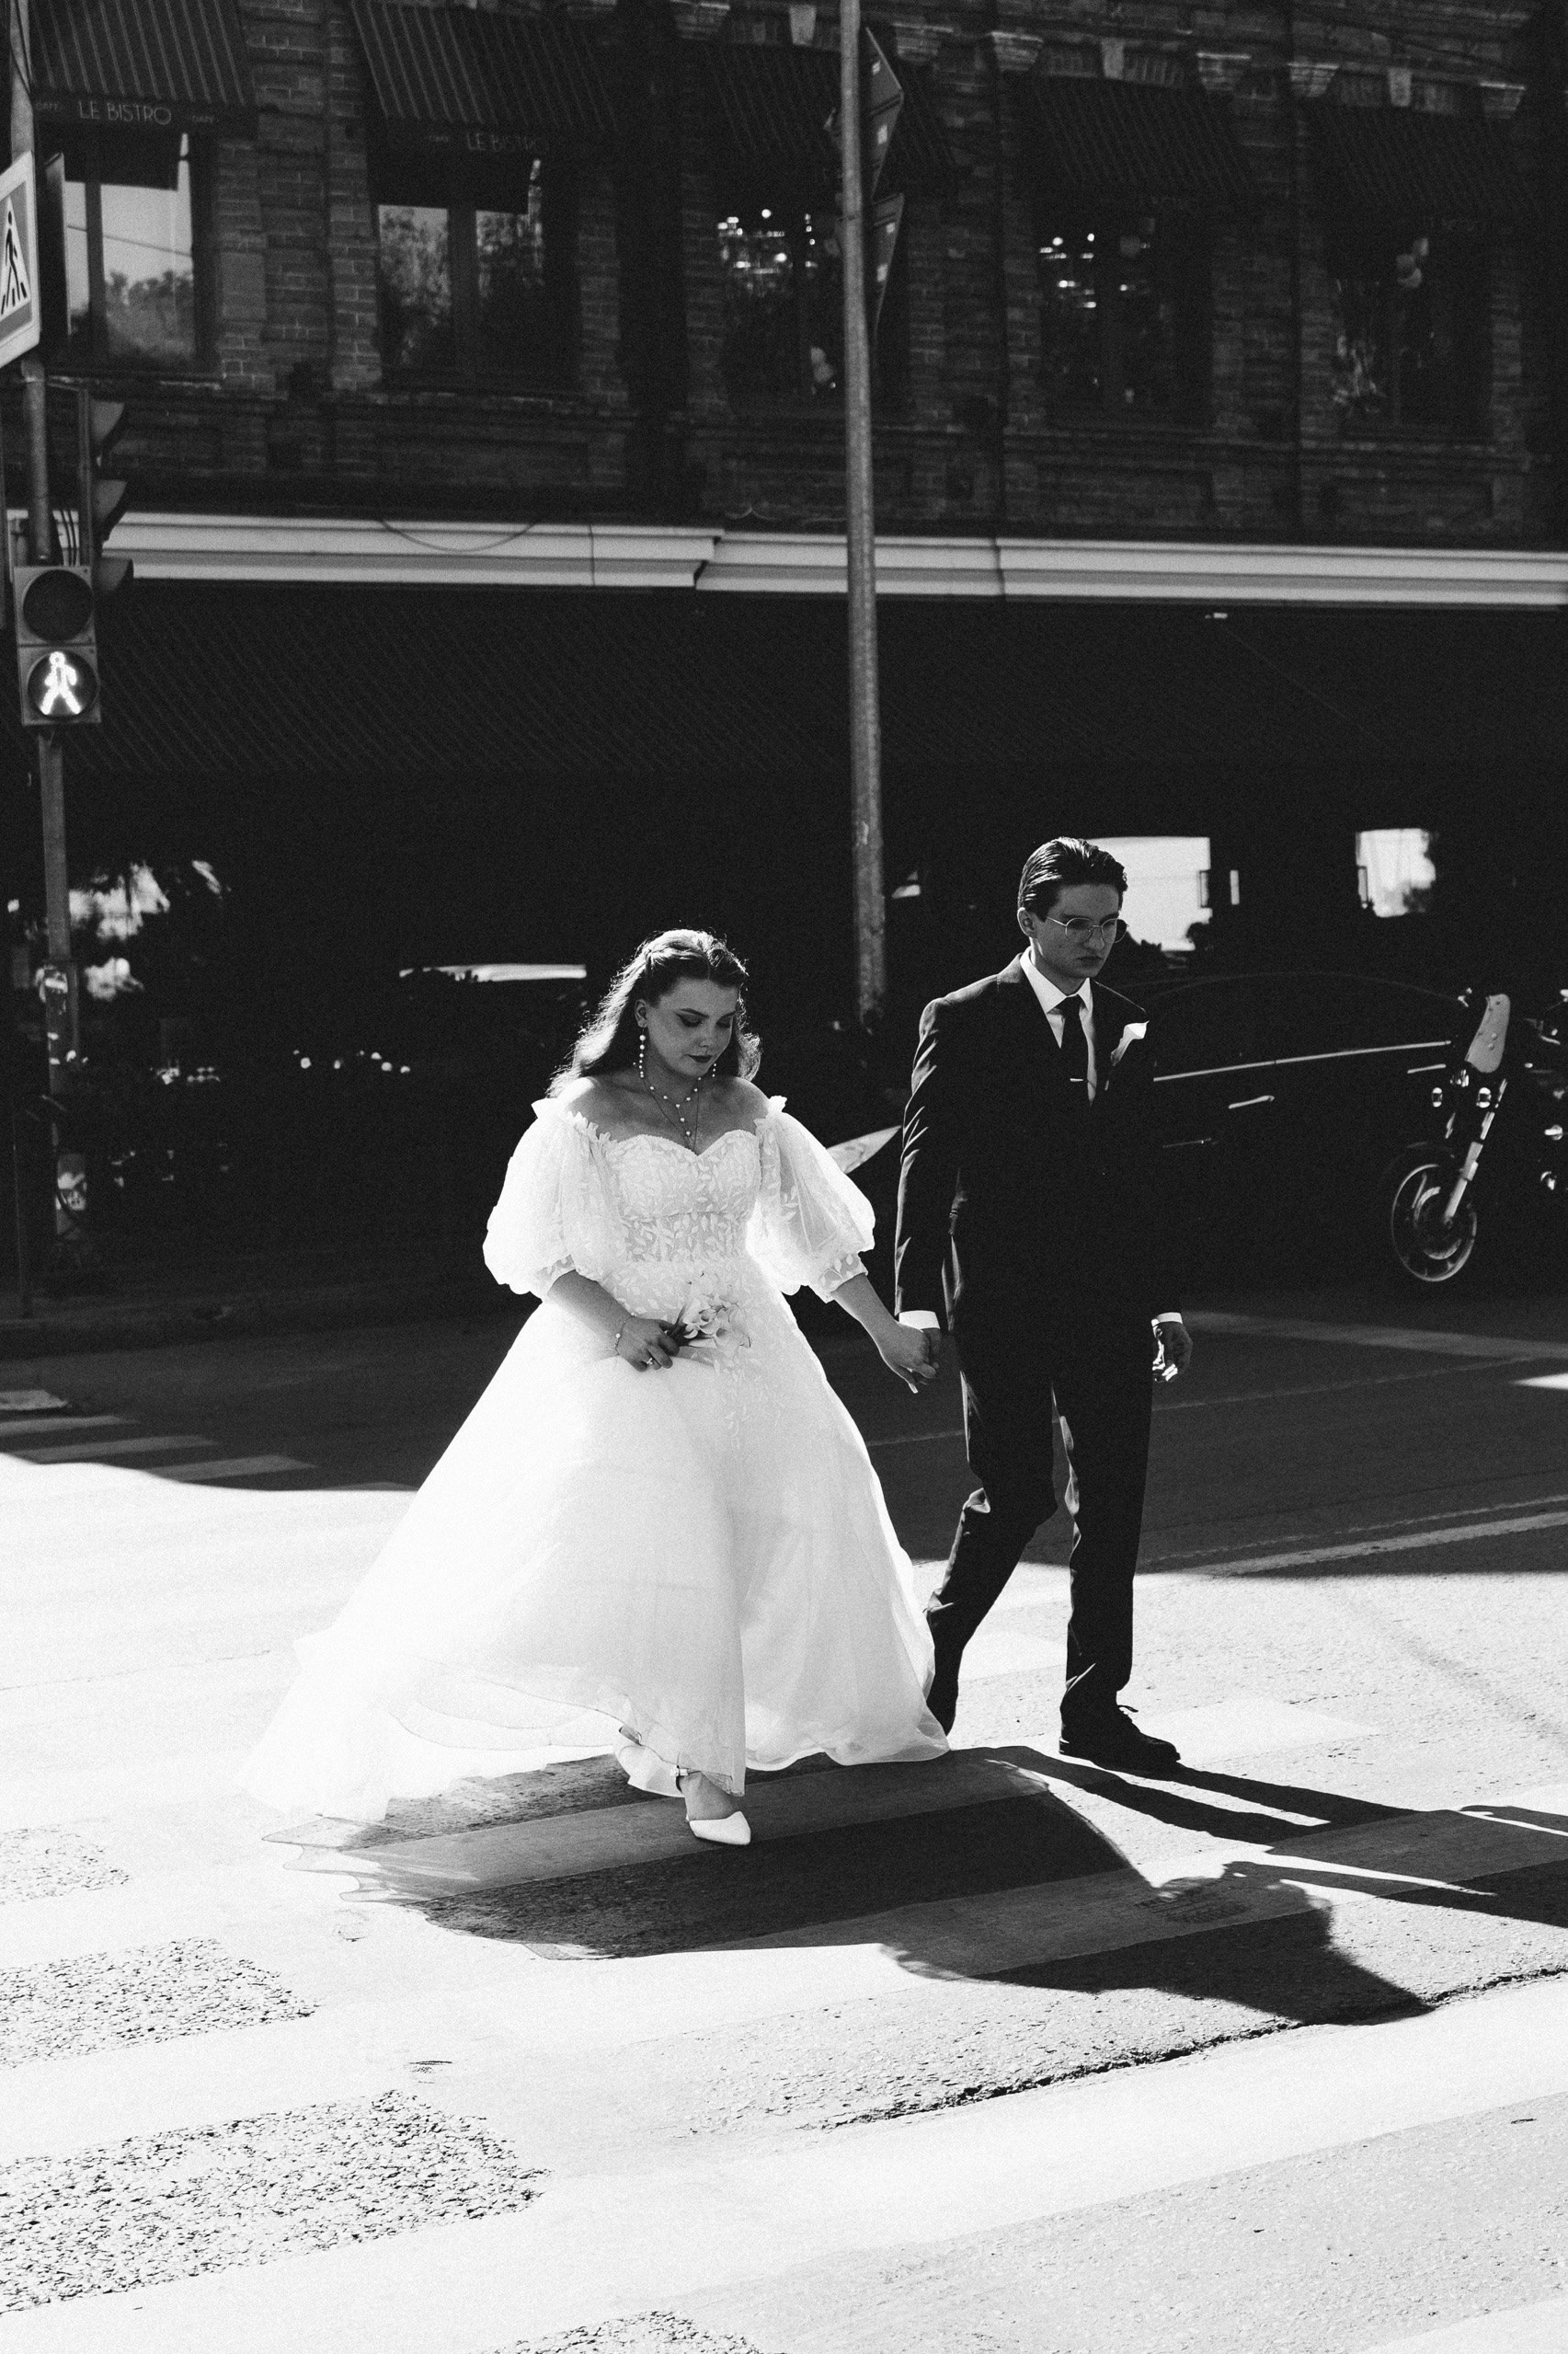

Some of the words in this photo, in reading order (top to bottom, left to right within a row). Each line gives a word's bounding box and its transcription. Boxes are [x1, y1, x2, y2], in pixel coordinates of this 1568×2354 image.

[78, 99, 101, 120] LE
[106, 101, 172, 126] BISTRO
[465, 132, 486, 151] LE
